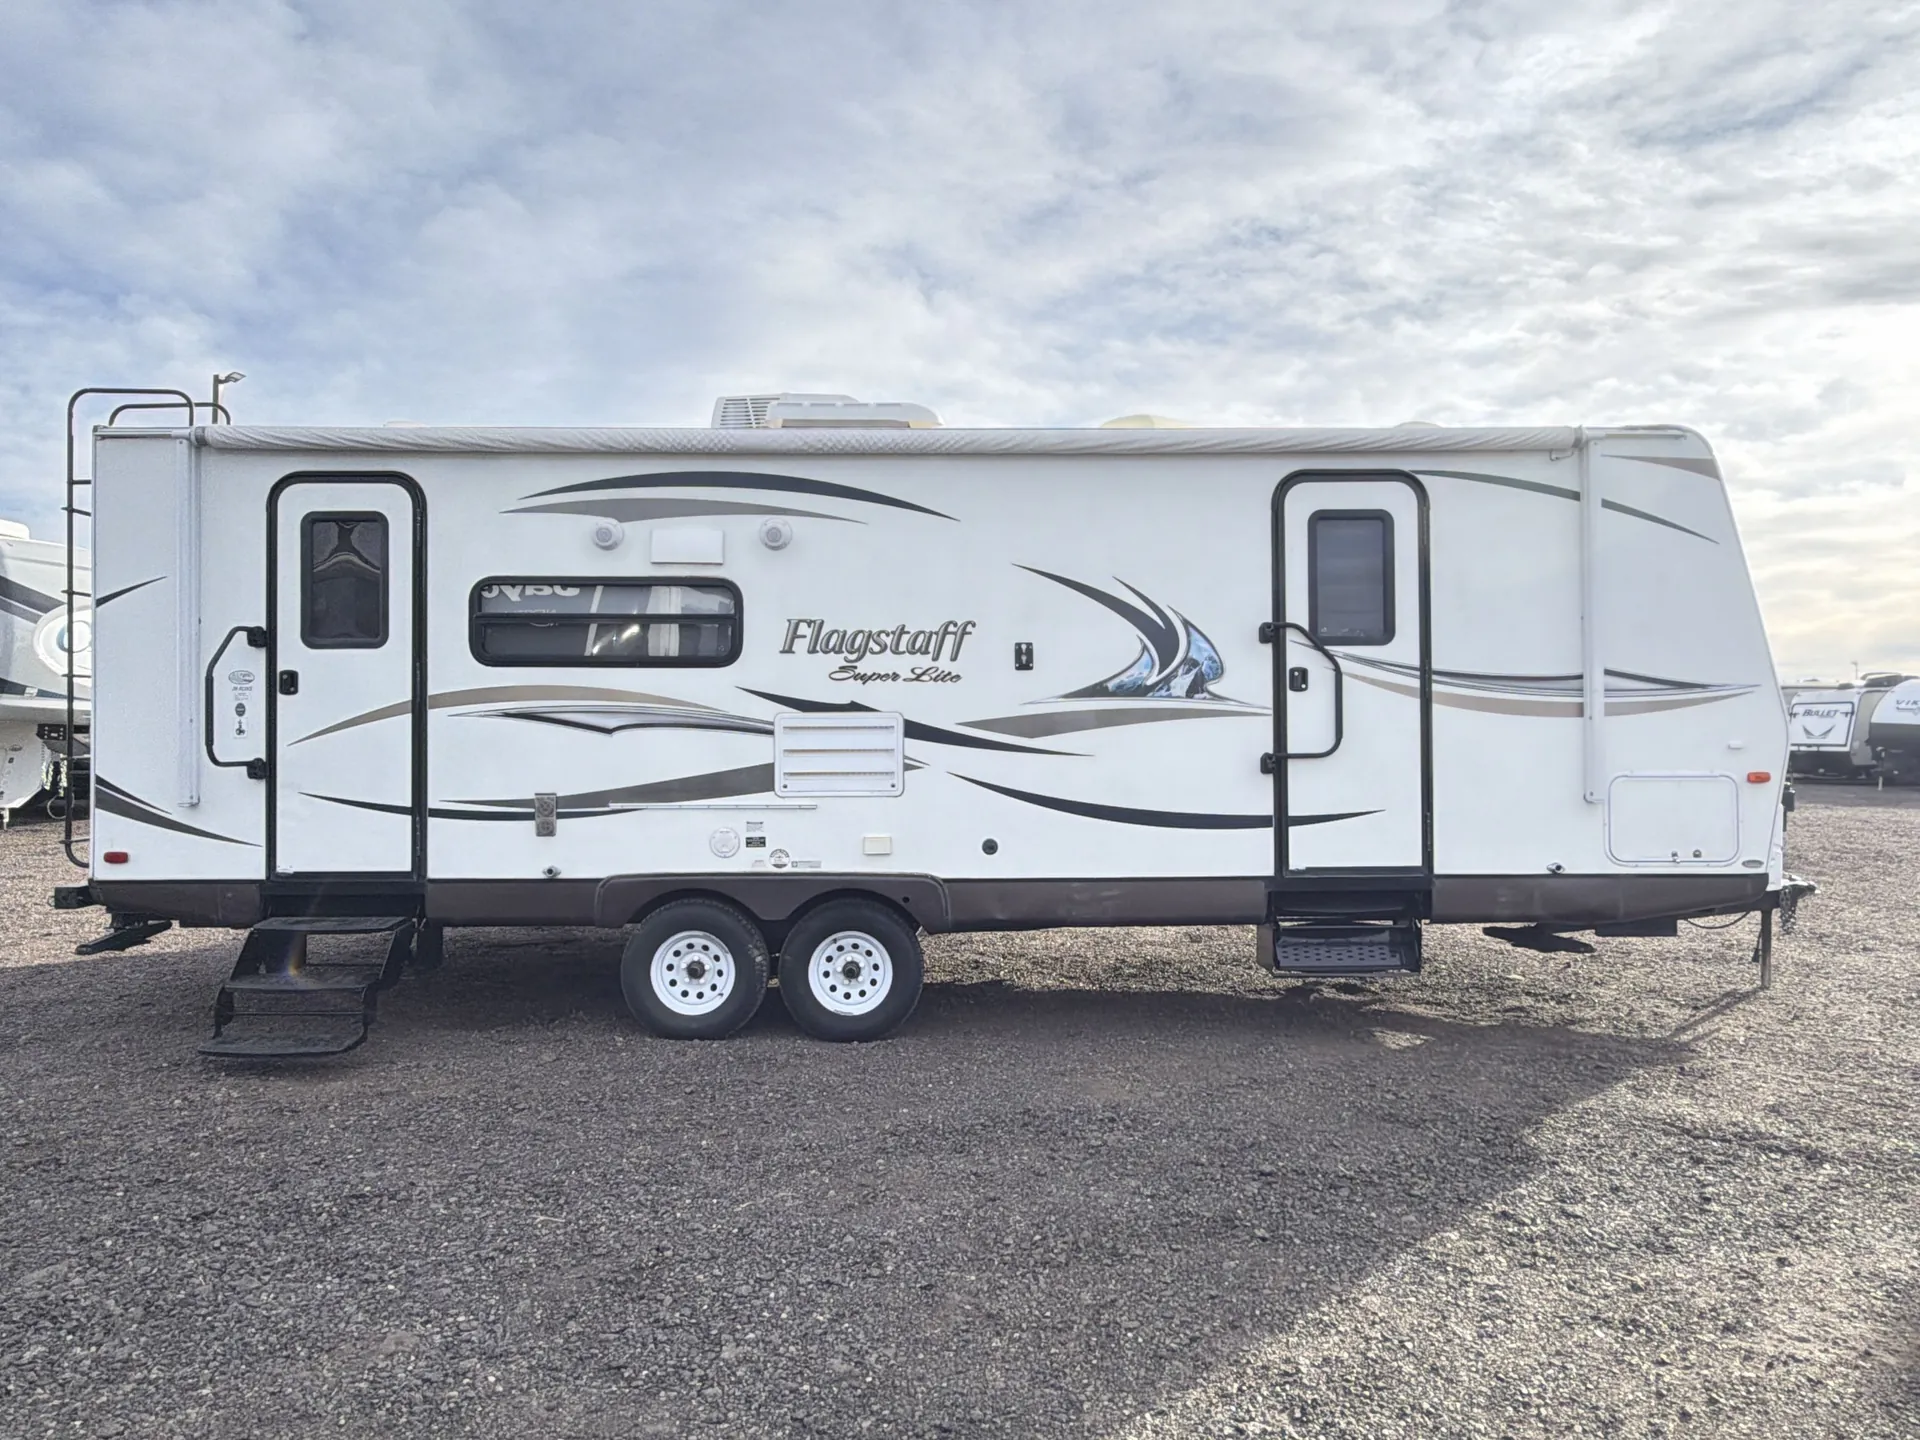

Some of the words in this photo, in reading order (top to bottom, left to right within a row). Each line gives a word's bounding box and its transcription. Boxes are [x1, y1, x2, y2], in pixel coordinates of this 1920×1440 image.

[779, 618, 976, 663] Flagstaff
[829, 665, 901, 685] Super
[903, 666, 963, 683] Lite
[1802, 709, 1840, 718] BULLET
